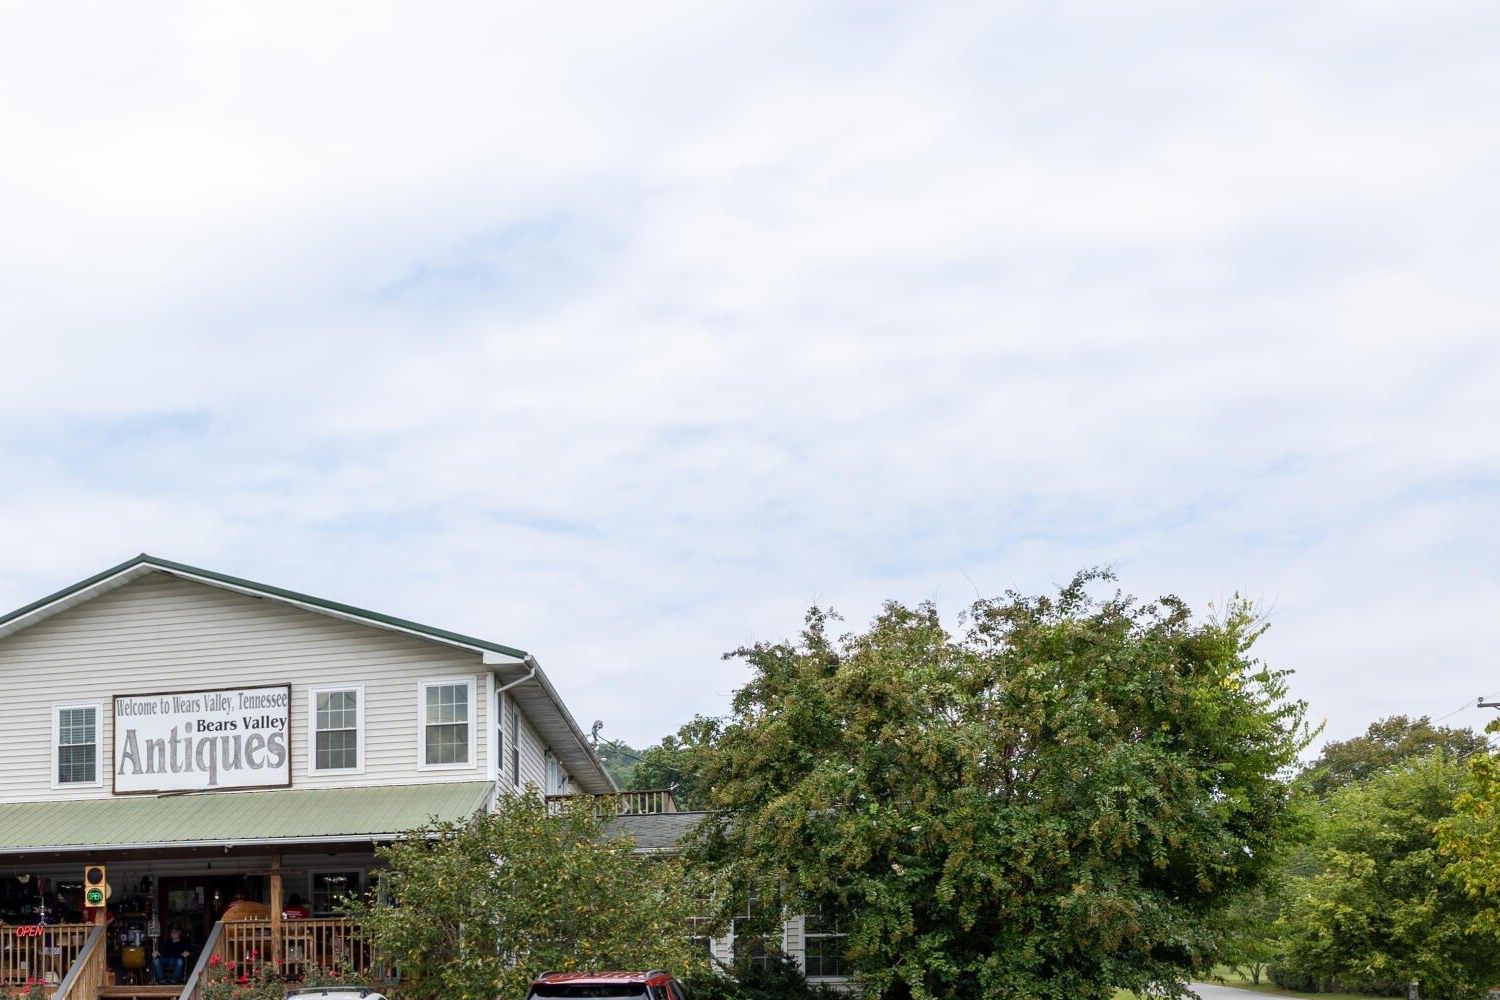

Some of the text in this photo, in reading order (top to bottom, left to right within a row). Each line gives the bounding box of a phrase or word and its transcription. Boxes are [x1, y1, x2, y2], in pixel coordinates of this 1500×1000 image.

[116, 692, 288, 717] Welcome to Wears Valley, Tennessee
[196, 715, 287, 732] Bears Valley
[117, 721, 286, 786] Antiques
[16, 925, 44, 937] OPEN
